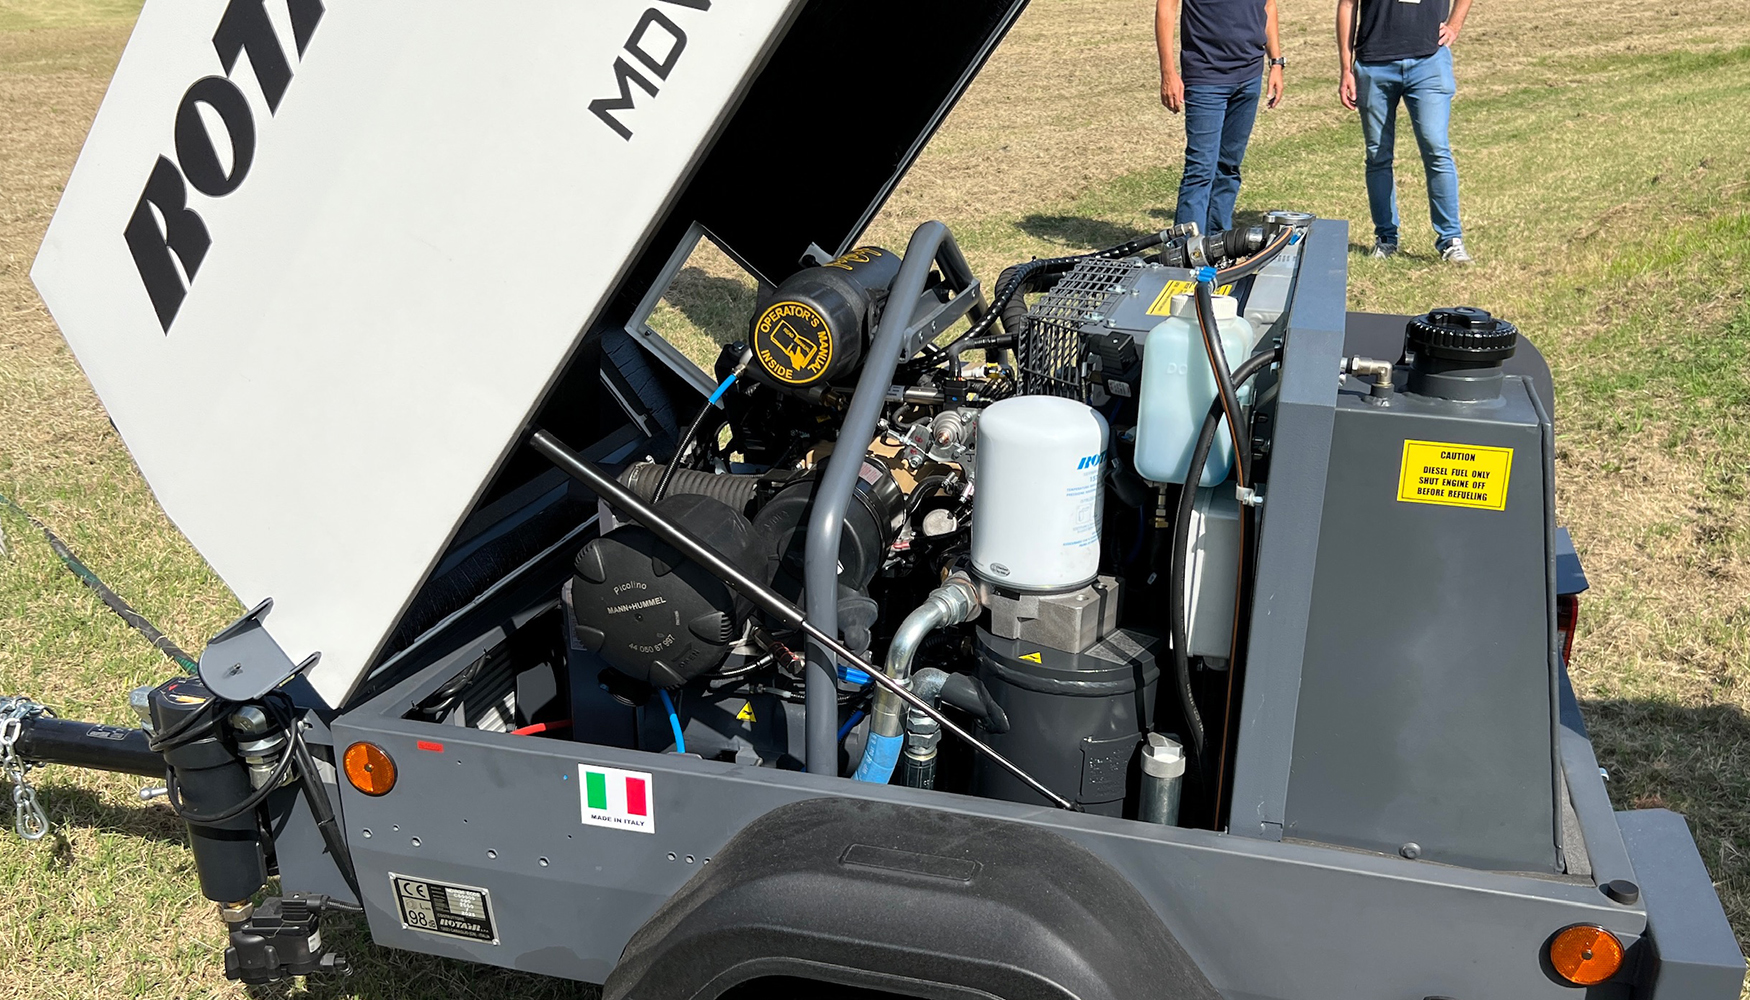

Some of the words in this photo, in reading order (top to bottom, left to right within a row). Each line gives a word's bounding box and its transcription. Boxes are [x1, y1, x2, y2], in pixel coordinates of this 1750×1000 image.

[587, 0, 712, 142] MD
[123, 0, 326, 337] ROT
[760, 305, 820, 333] OPERATOR'S
[807, 330, 829, 374] MANUAL
[761, 349, 793, 379] INSIDE
[1440, 451, 1476, 461] CAUTION
[1423, 466, 1448, 475] DIESEL
[1451, 468, 1468, 477] FUEL
[1471, 470, 1490, 479] ONLY
[1418, 476, 1439, 485] SHUT
[1442, 478, 1469, 488] ENGINE
[1472, 481, 1486, 490] OFF
[1417, 487, 1445, 497] BEFORE
[1448, 490, 1488, 501] REFUELING
[613, 581, 647, 595] Picolino
[607, 597, 667, 614] MANN+HUMMEL
[590, 814, 612, 822] MADE
[624, 819, 645, 827] ITALY
[403, 882, 426, 898] CE
[408, 910, 428, 926] 98
